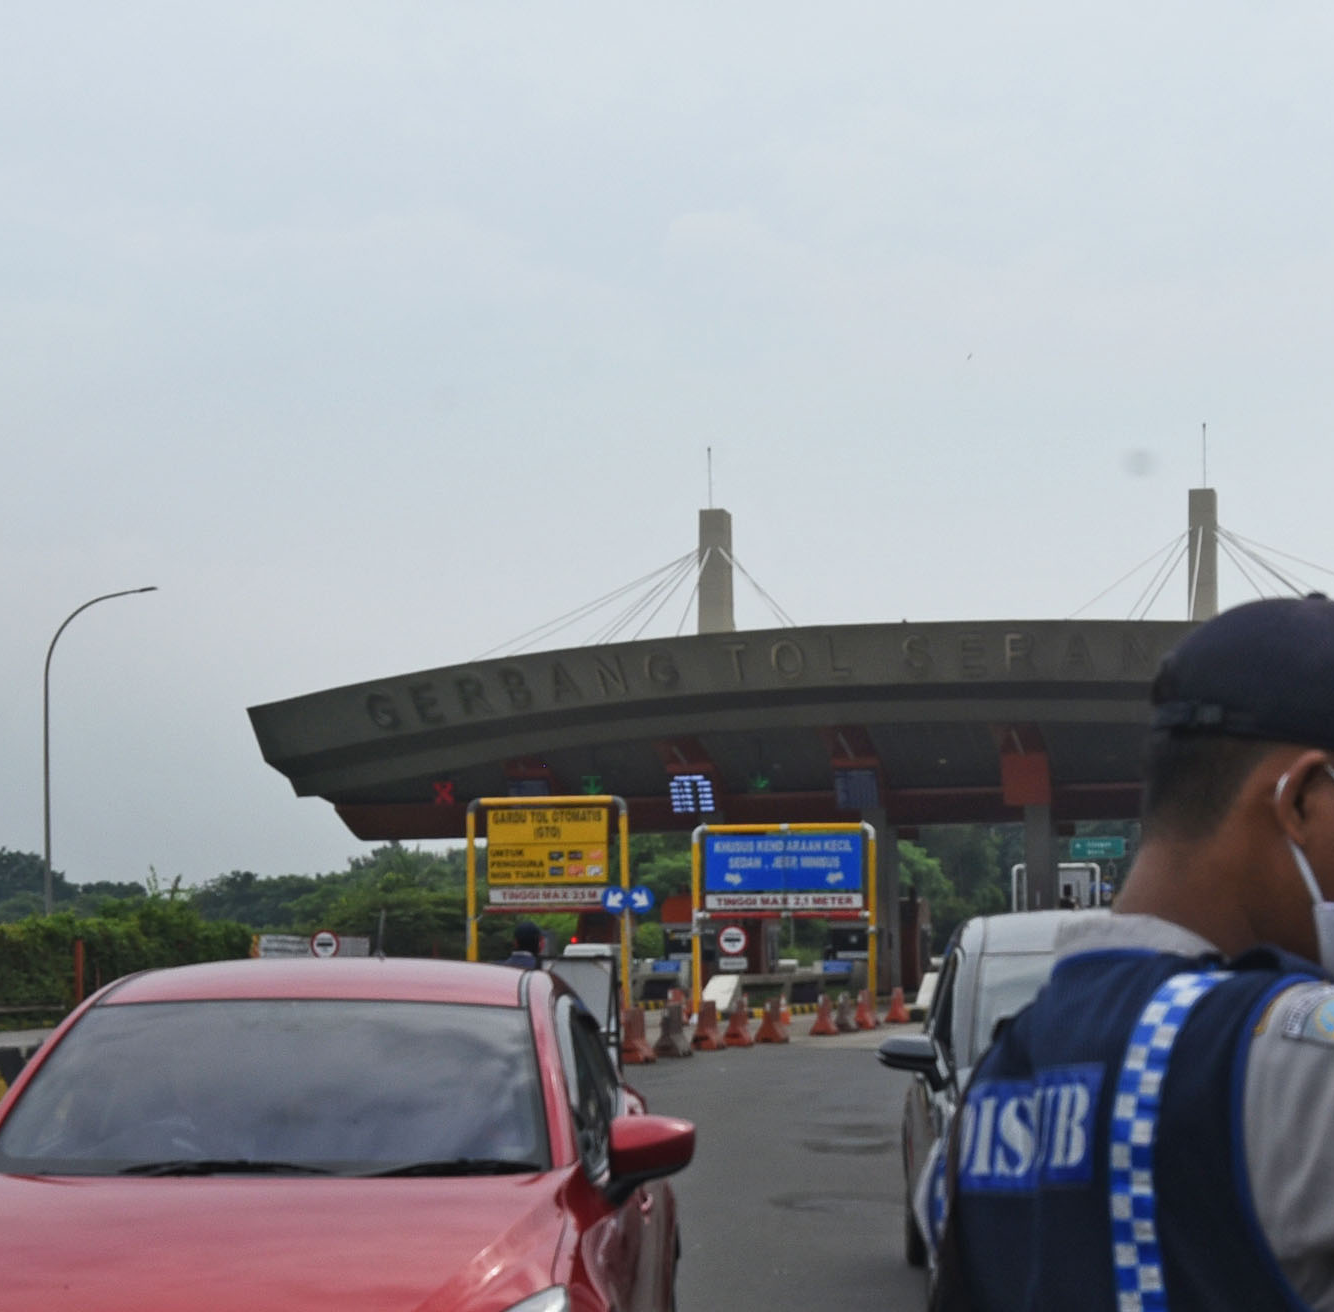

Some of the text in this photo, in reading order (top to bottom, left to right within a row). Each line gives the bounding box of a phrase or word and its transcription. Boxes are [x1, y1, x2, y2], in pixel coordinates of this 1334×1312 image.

[367, 631, 1161, 730] GERBANG TOL SERAN
[492, 808, 603, 825] GARDU TOL OTOMATIS
[715, 896, 758, 906] TINGGI
[812, 895, 854, 905] METER
